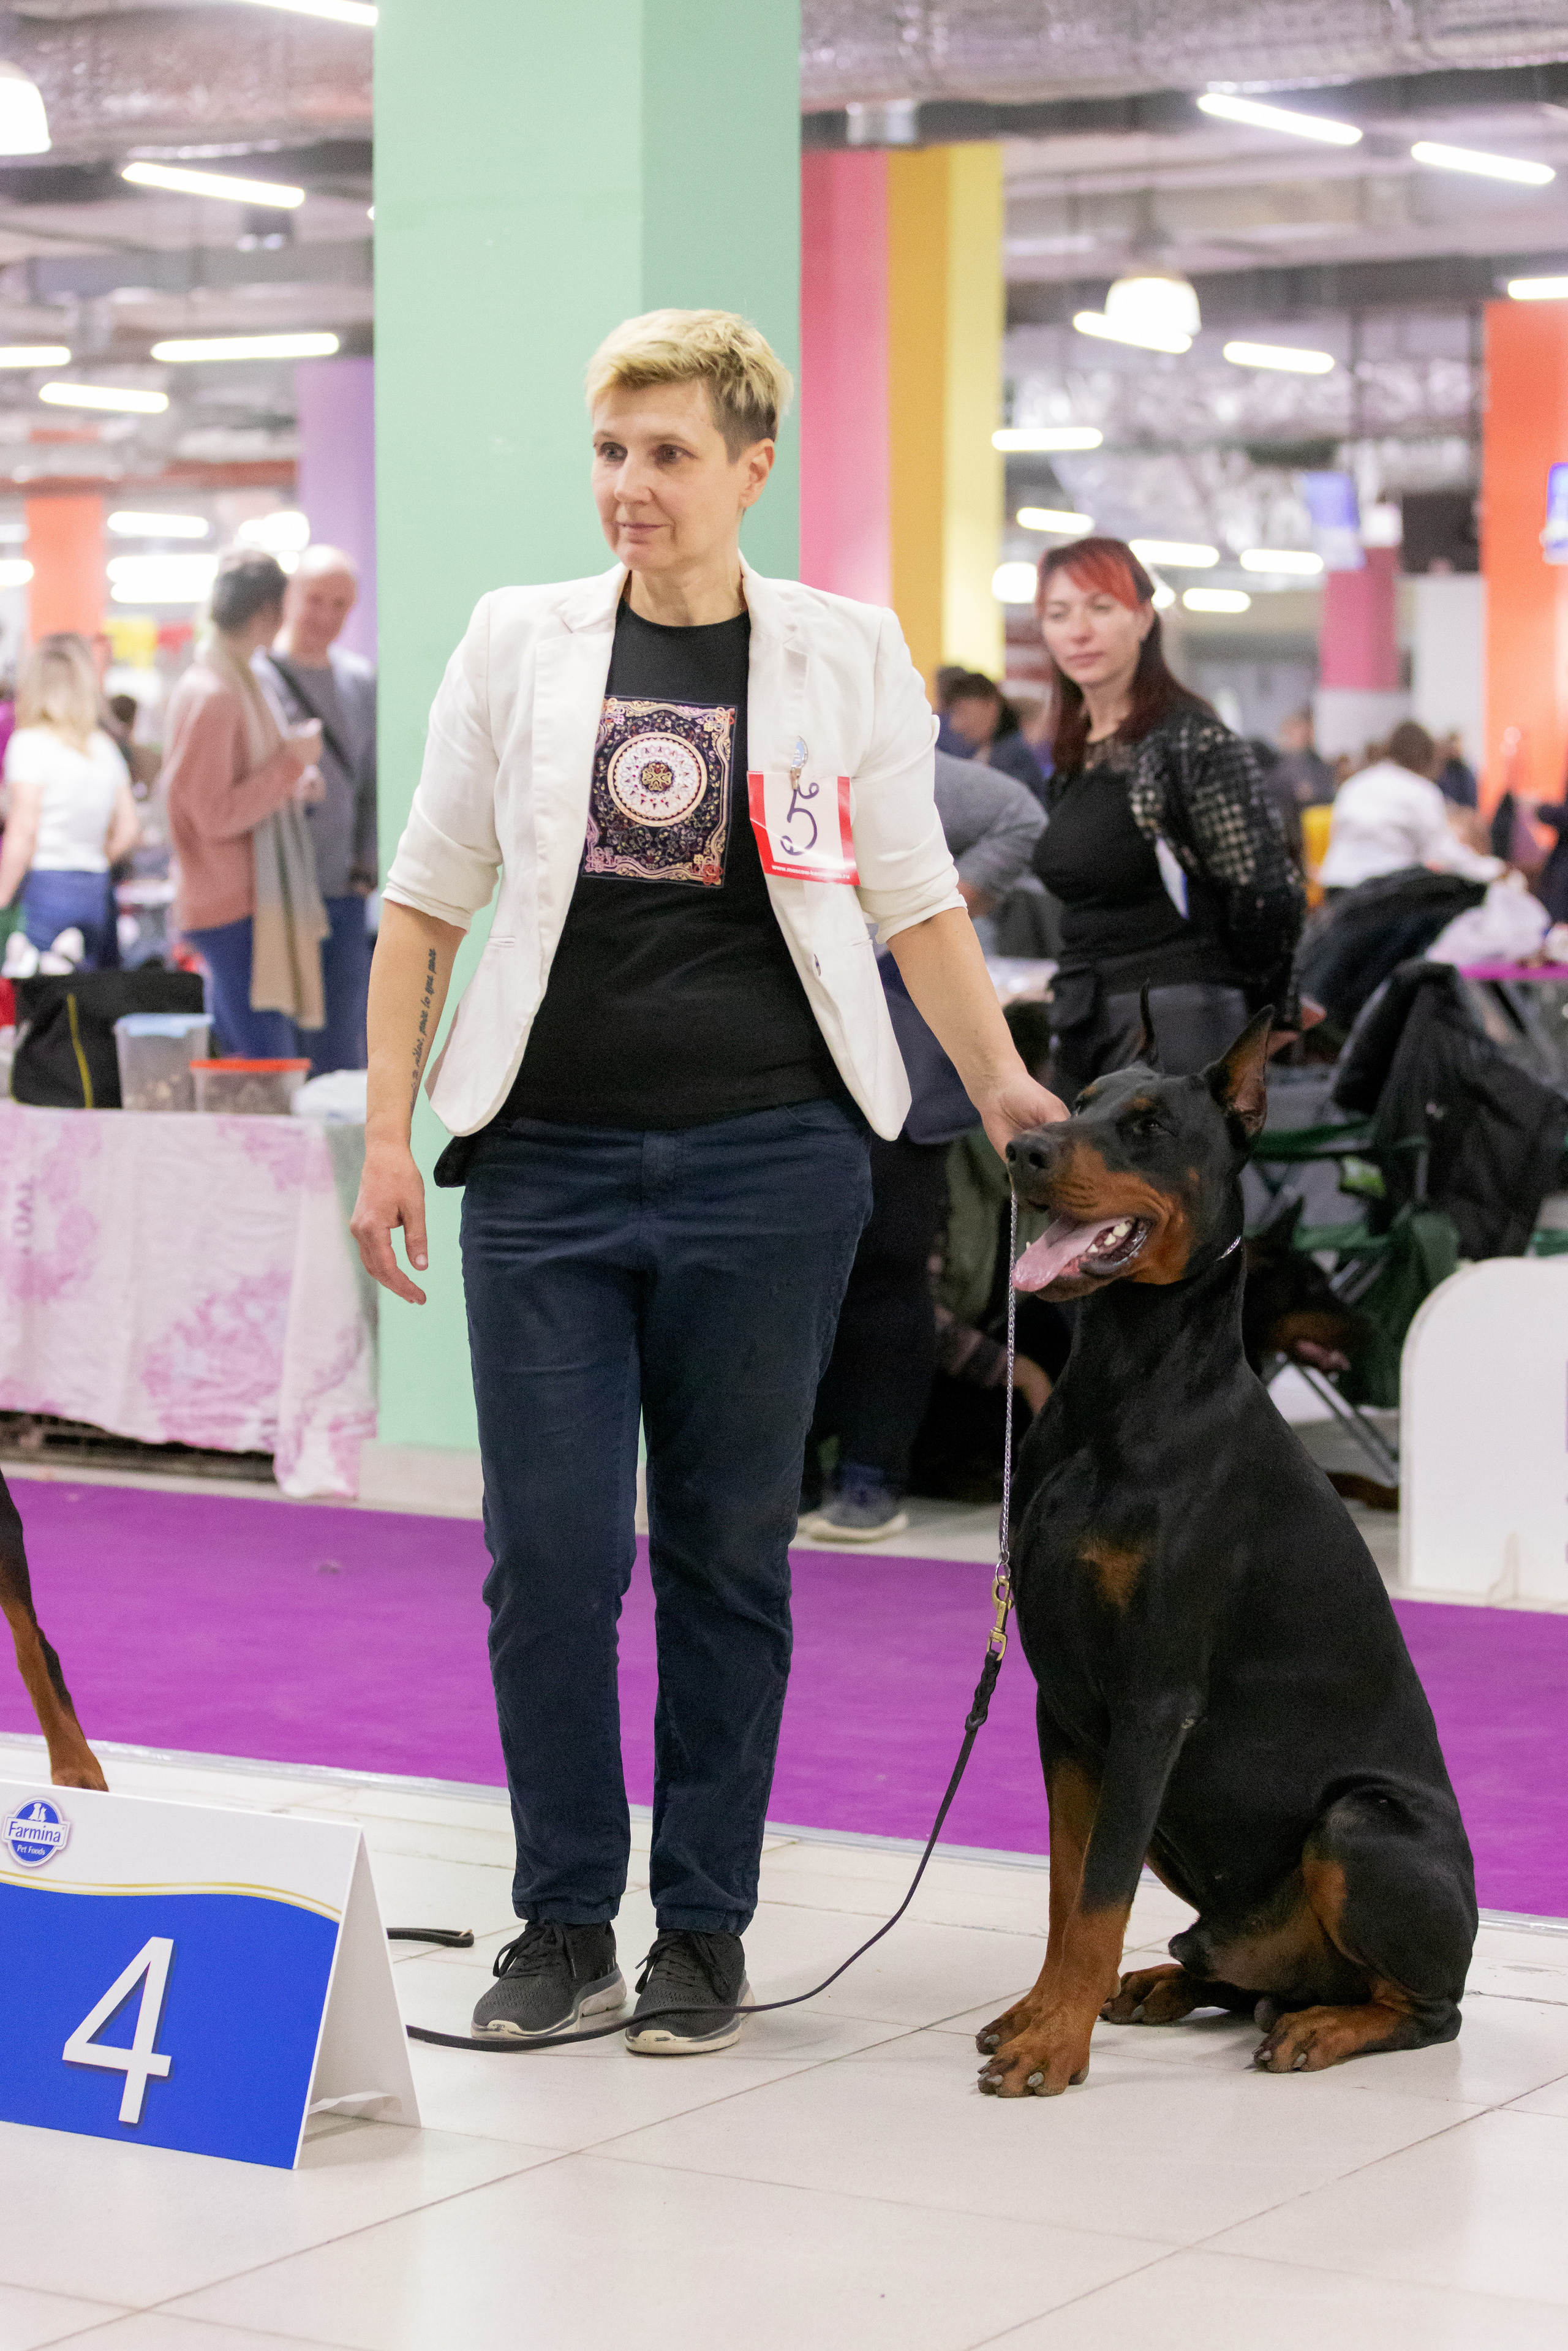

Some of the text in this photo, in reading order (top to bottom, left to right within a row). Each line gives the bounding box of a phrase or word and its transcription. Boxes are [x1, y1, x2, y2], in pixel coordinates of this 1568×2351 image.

[9, 1821, 61, 1843] Farmina
[17, 1844, 46, 1855] Pet Foods
[62, 1936, 174, 2124] 4
